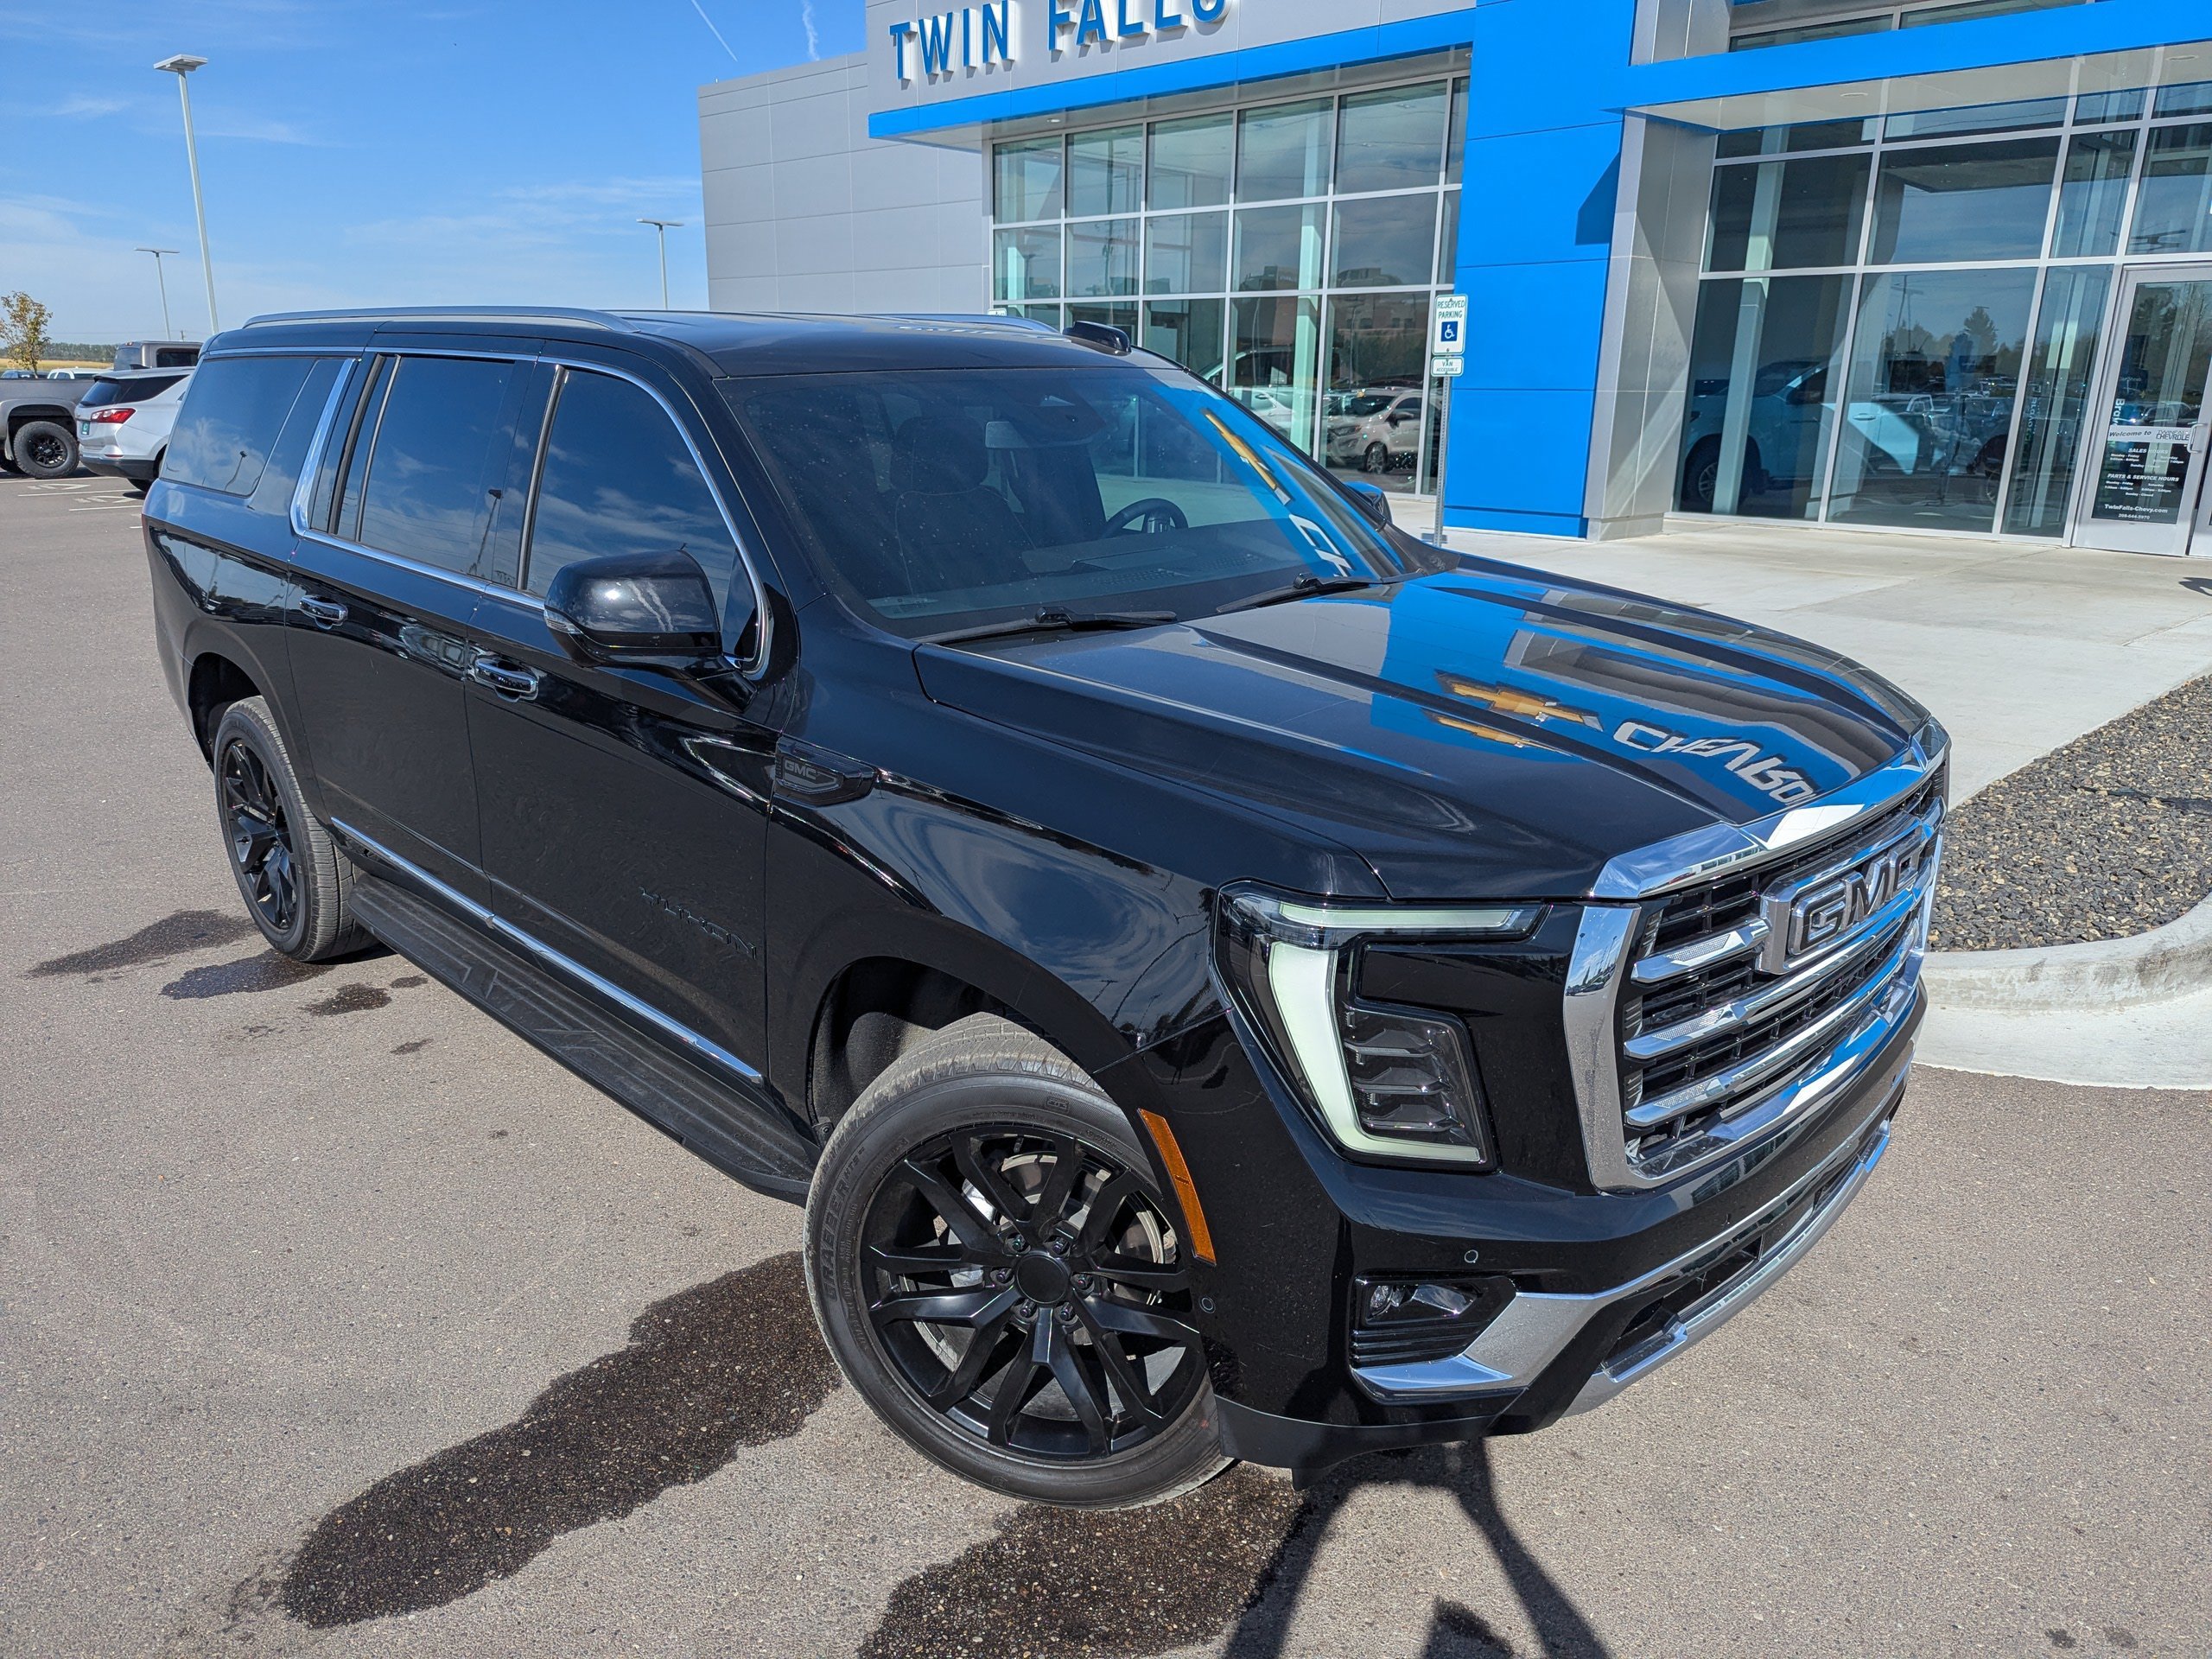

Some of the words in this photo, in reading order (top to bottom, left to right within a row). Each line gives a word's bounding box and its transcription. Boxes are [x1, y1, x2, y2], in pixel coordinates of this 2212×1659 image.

[889, 0, 1014, 80] TWIN
[1437, 300, 1465, 308] RESERVED
[1438, 310, 1463, 319] PARKING
[2104, 504, 2169, 513] TwinFalls-Chevy.com
[784, 759, 817, 780] GMC
[1788, 828, 1924, 956] GMC
[822, 1177, 852, 1302] GRABBER
